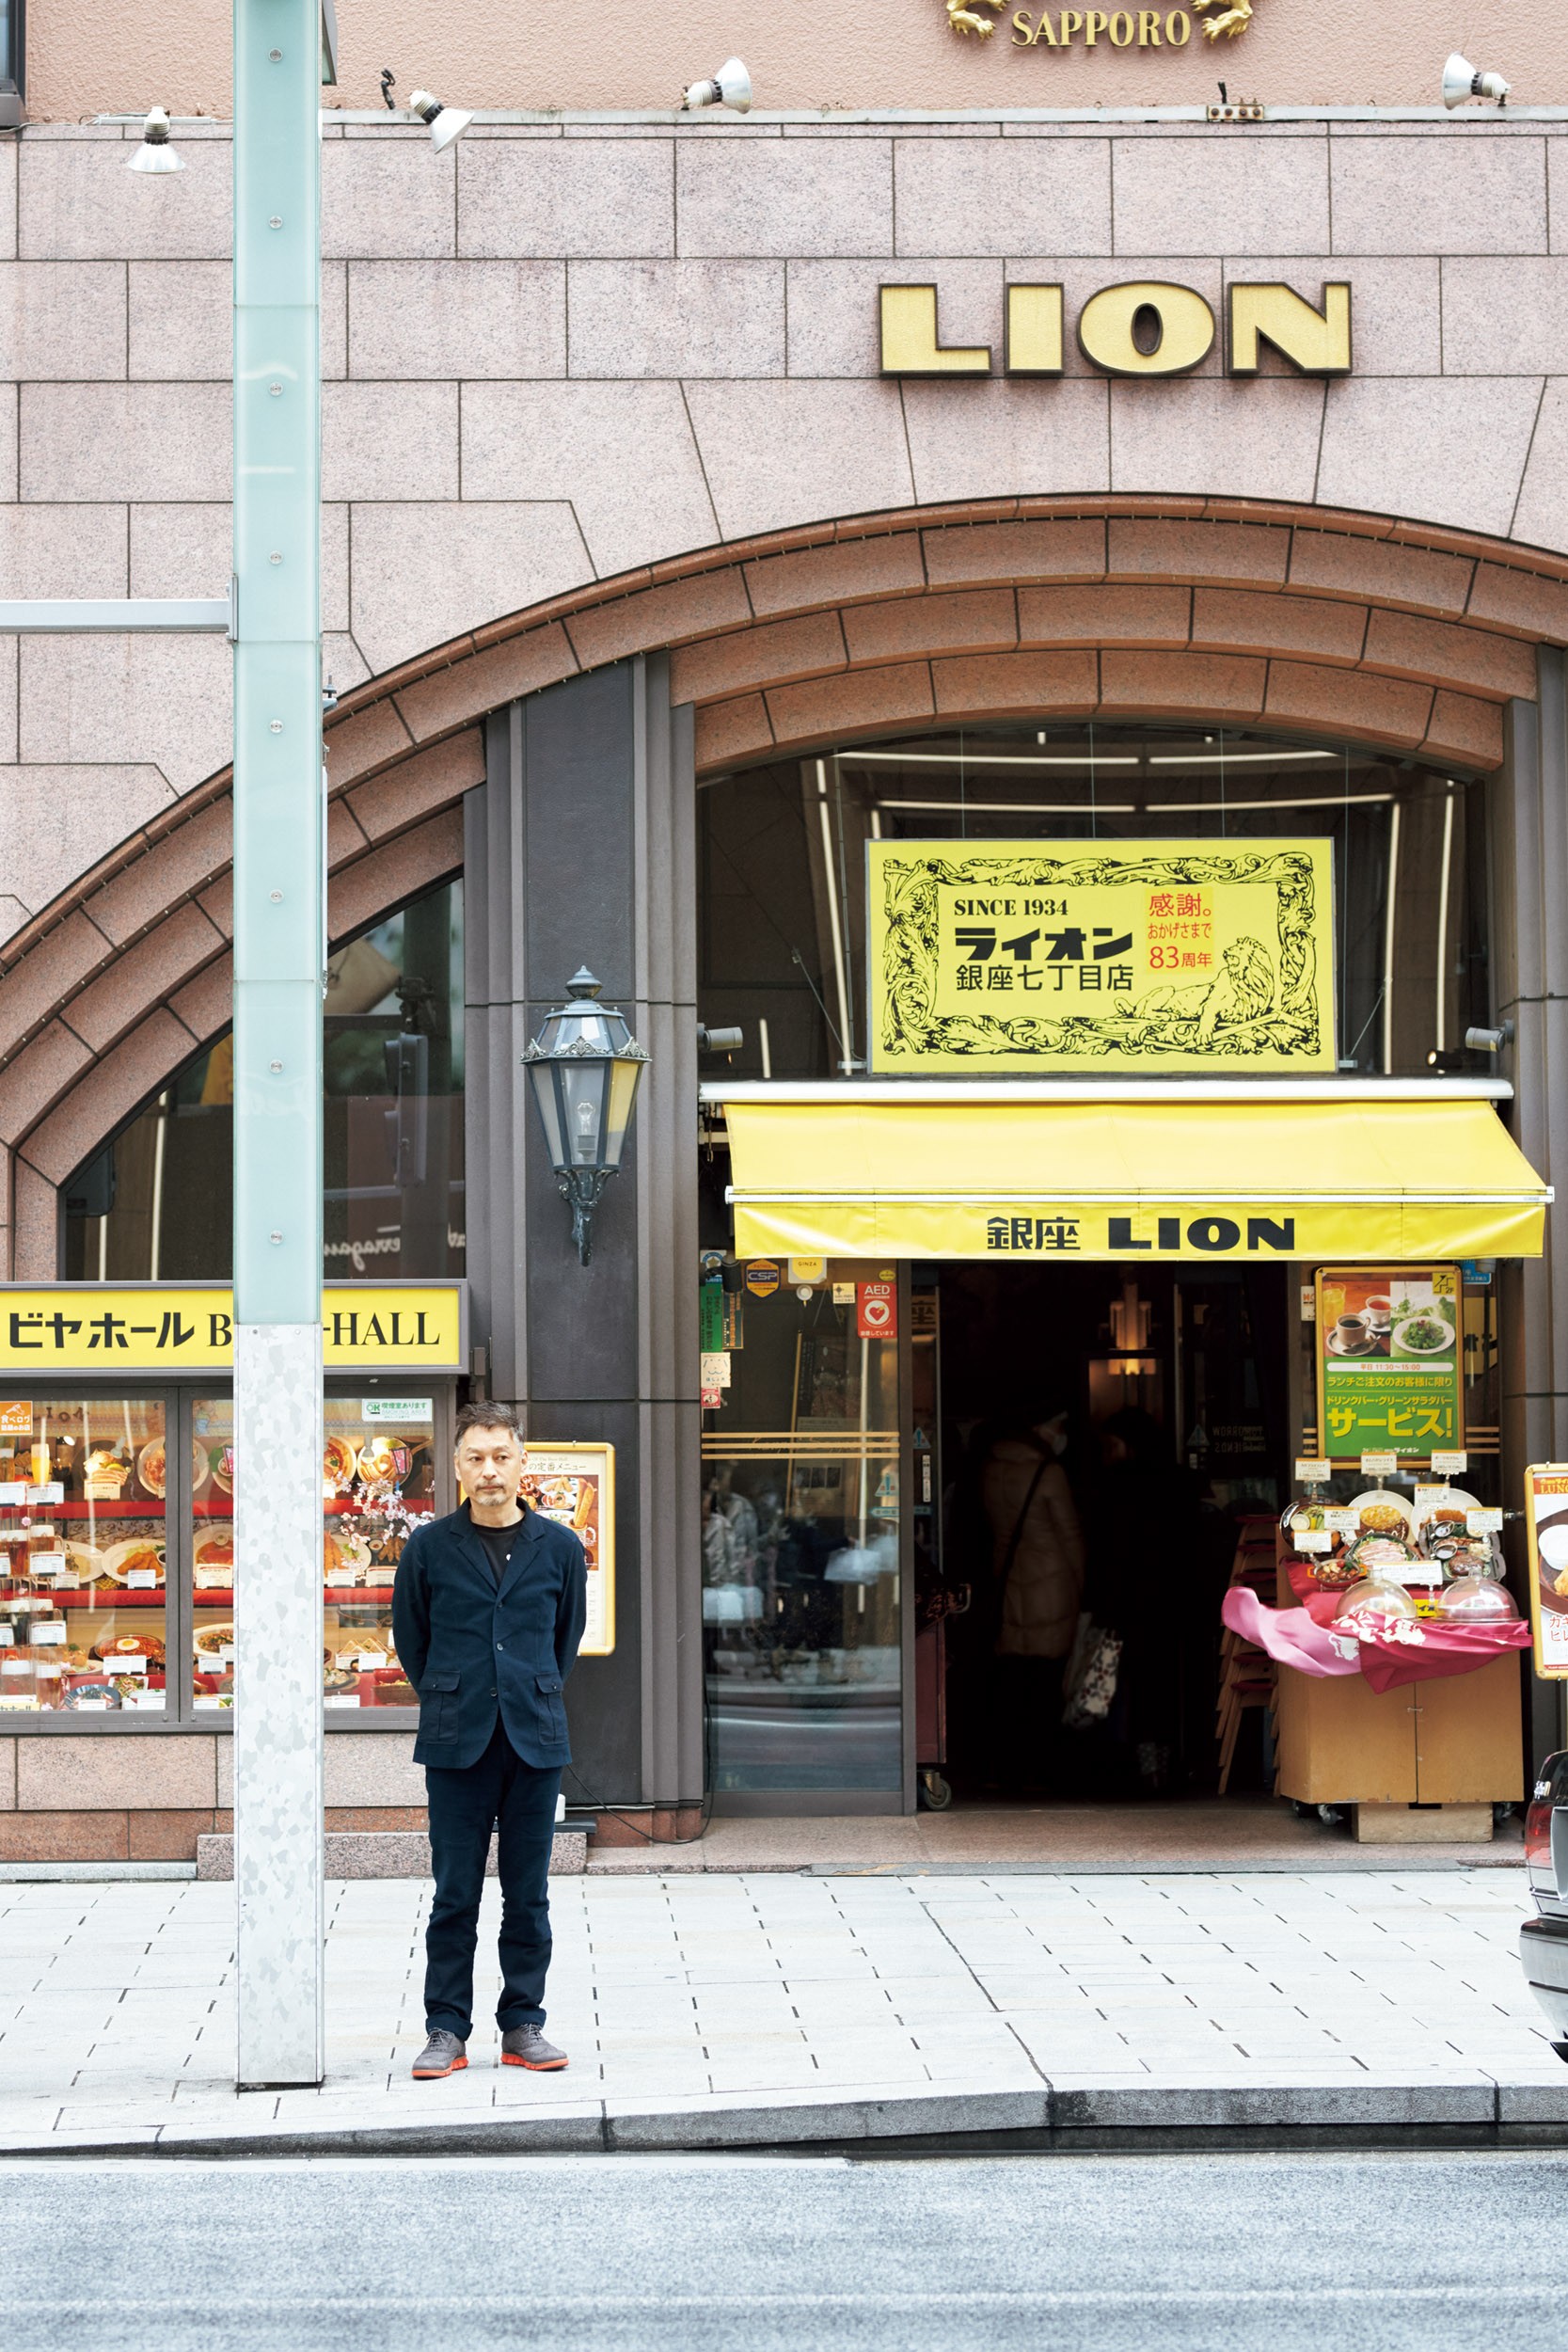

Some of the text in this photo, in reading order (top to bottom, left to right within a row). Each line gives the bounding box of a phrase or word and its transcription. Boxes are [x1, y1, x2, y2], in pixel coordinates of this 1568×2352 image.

[1011, 10, 1191, 46] SAPPORO
[879, 280, 1352, 374] LION
[954, 899, 1069, 915] SINCE 1934
[1148, 893, 1212, 917] 感謝。
[1148, 922, 1212, 939] おかげさまで
[955, 928, 1132, 961] ライオン
[1149, 946, 1212, 969] 83周年
[956, 964, 1133, 991] 銀座七丁目店
[988, 1216, 1294, 1250] 銀座 LION
[748, 1272, 777, 1280] CSP
[864, 1285, 890, 1295] AED
[9, 1312, 195, 1348] ビヤホール
[1327, 1376, 1453, 1388] ランチご注文のお客様に限り
[1327, 1406, 1452, 1438] サービス!
